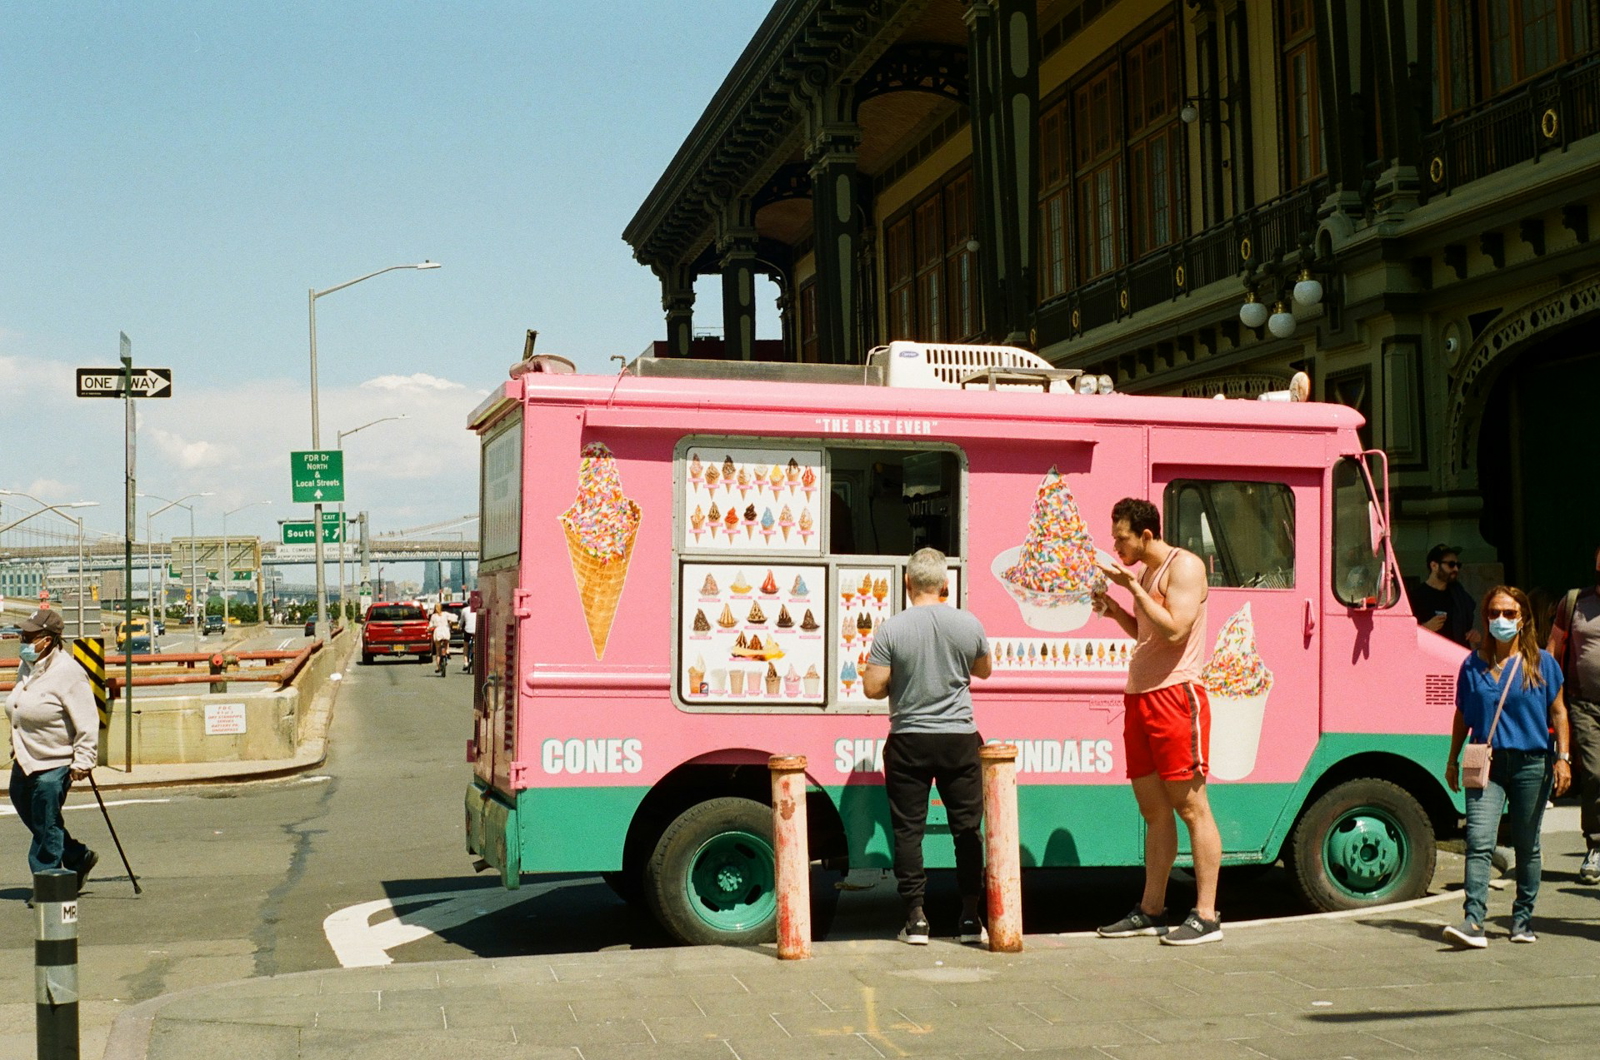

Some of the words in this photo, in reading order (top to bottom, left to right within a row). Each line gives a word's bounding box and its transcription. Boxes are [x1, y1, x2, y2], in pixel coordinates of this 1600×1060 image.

[84, 377, 113, 389] ONE
[130, 377, 159, 389] WAY
[815, 418, 849, 433] "THE
[854, 419, 891, 434] BEST
[896, 420, 938, 435] EVER"
[314, 471, 321, 479] &
[316, 479, 340, 487] Streets
[287, 530, 315, 538] South
[541, 738, 643, 774] CONES
[834, 738, 885, 773] SHA
[985, 739, 1114, 774] UNDAES
